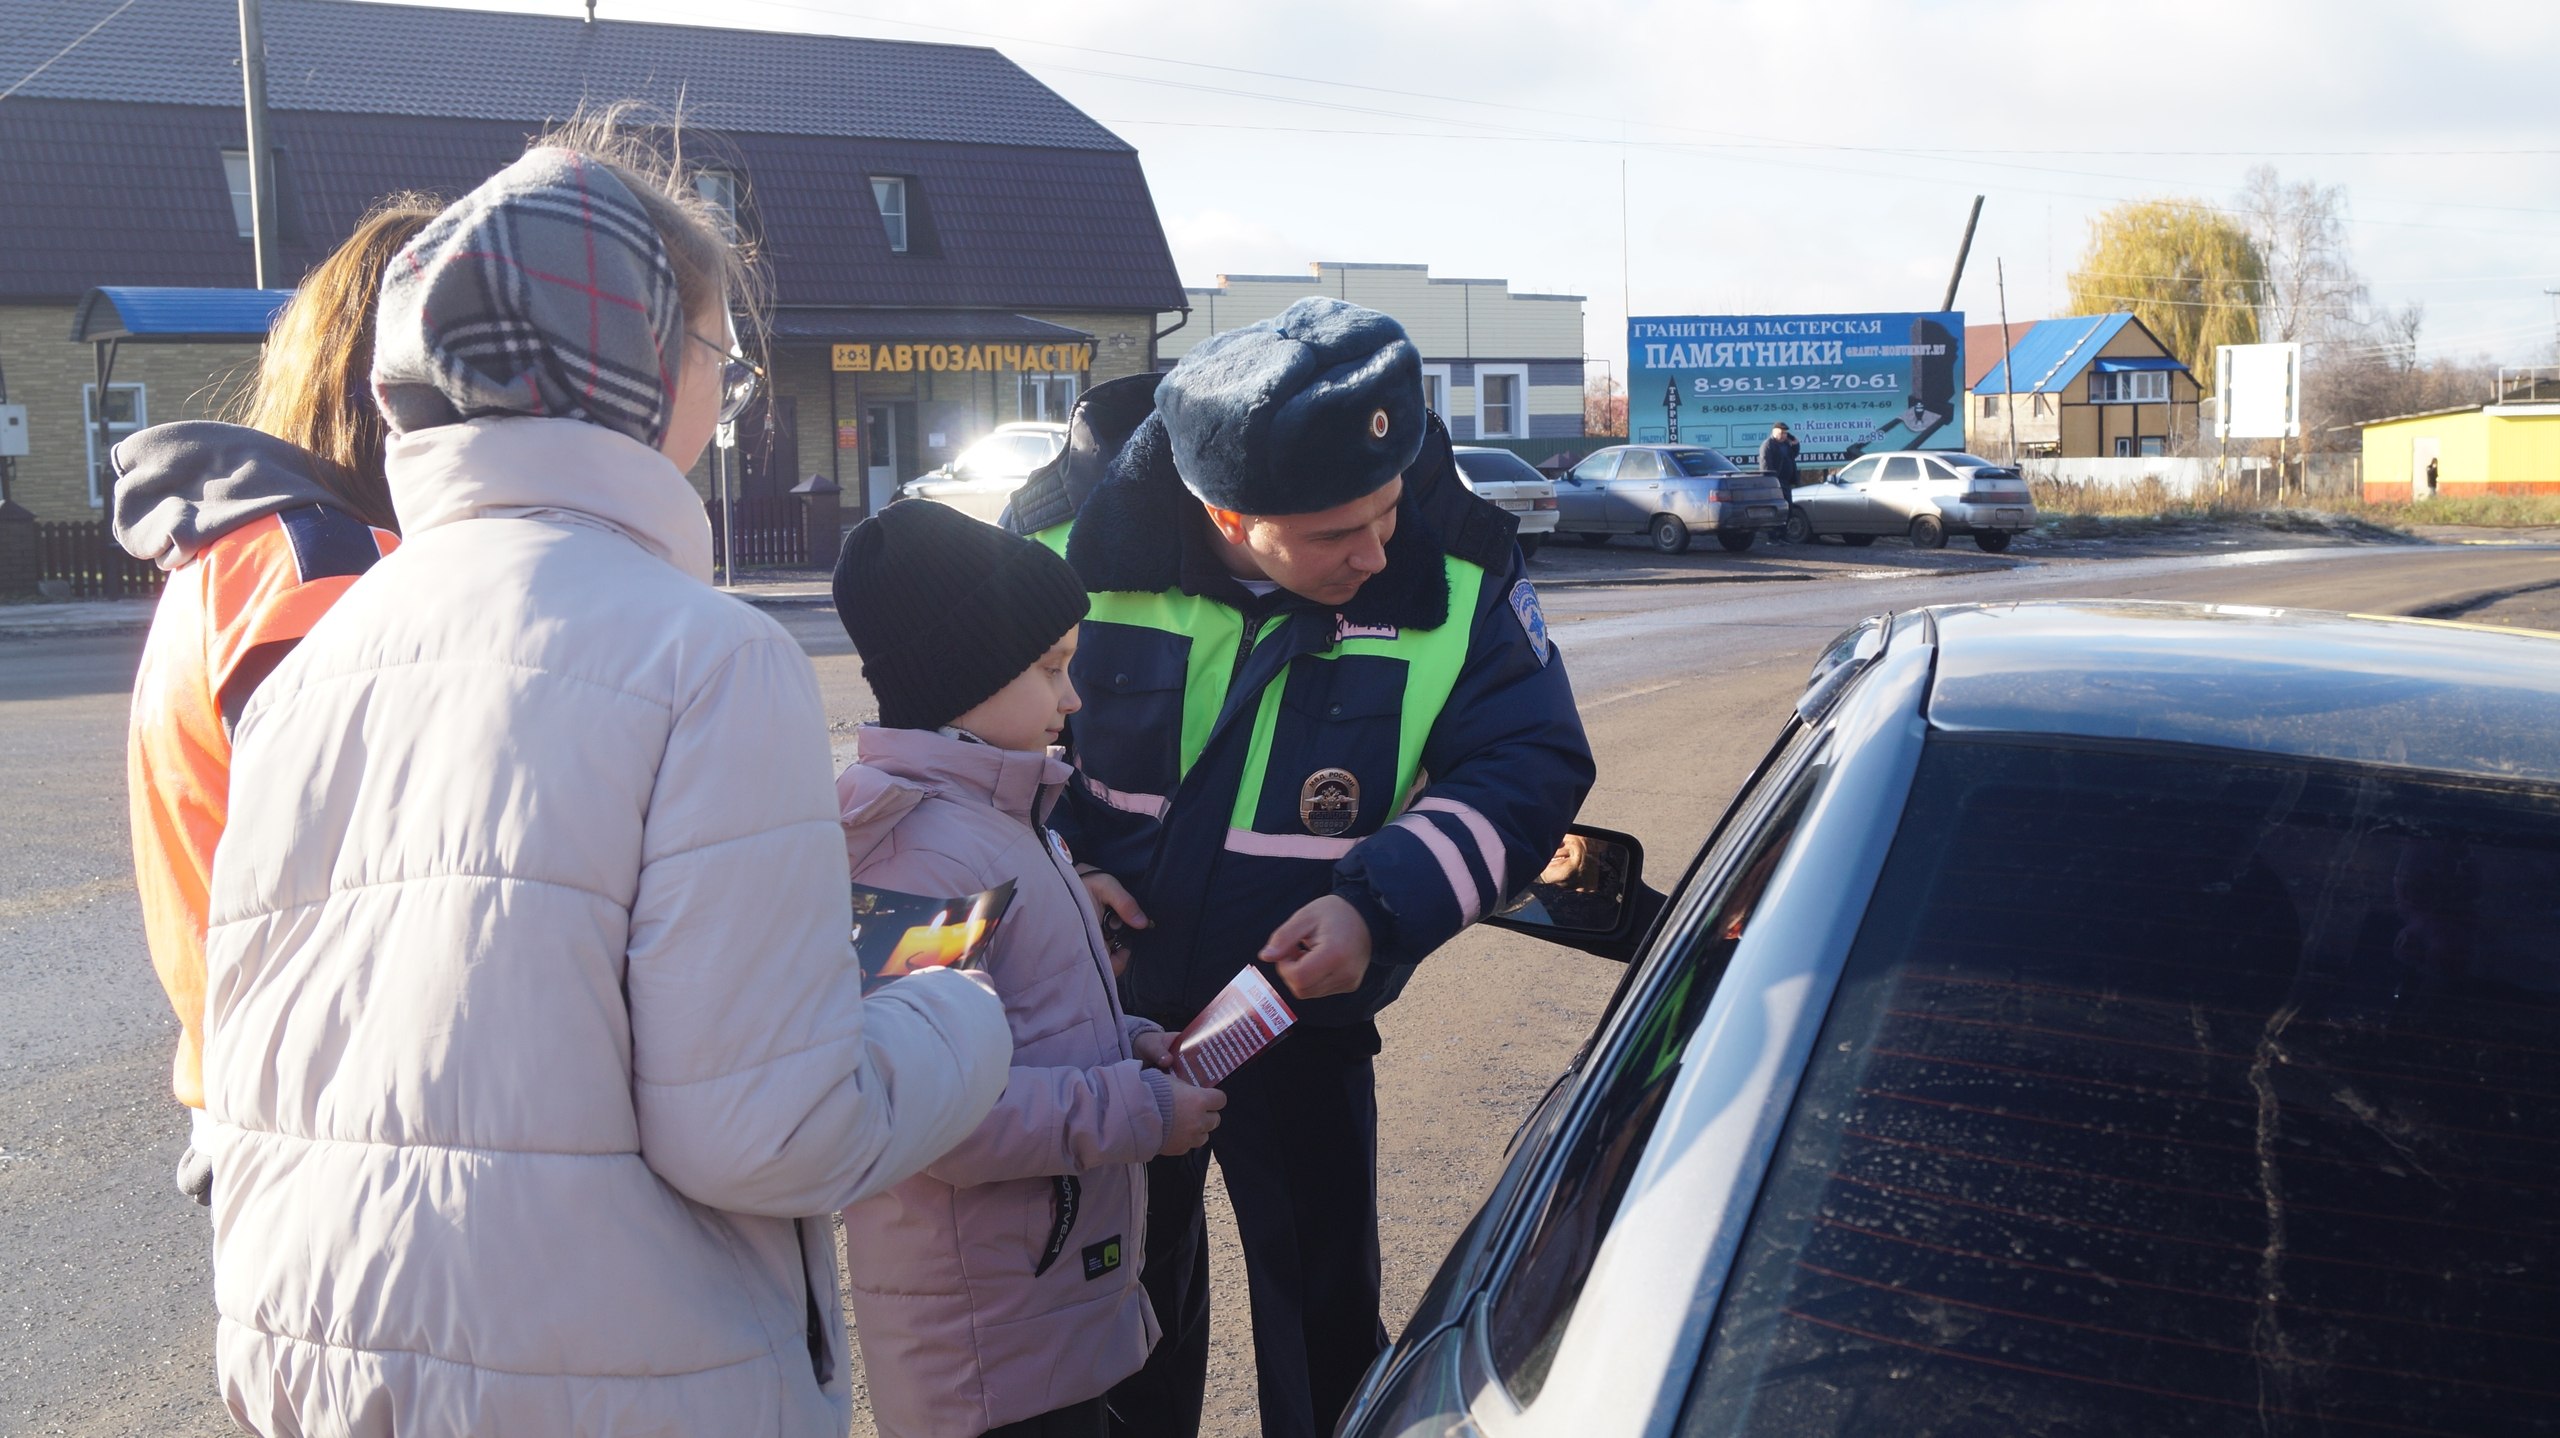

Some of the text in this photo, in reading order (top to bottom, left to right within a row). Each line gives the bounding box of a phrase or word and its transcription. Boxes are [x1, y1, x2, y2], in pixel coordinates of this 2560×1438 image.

[1634, 320, 1881, 337] ГРАНИТНАЯ МАСТЕРСКАЯ
[874, 344, 1090, 372] АВТОЗАПЧАСТИ
[1645, 341, 1843, 368] ПАМЯТНИКИ
[1694, 374, 1898, 392] 8-961-192-70-61
[1309, 772, 1355, 788] МВД РОССИИ
